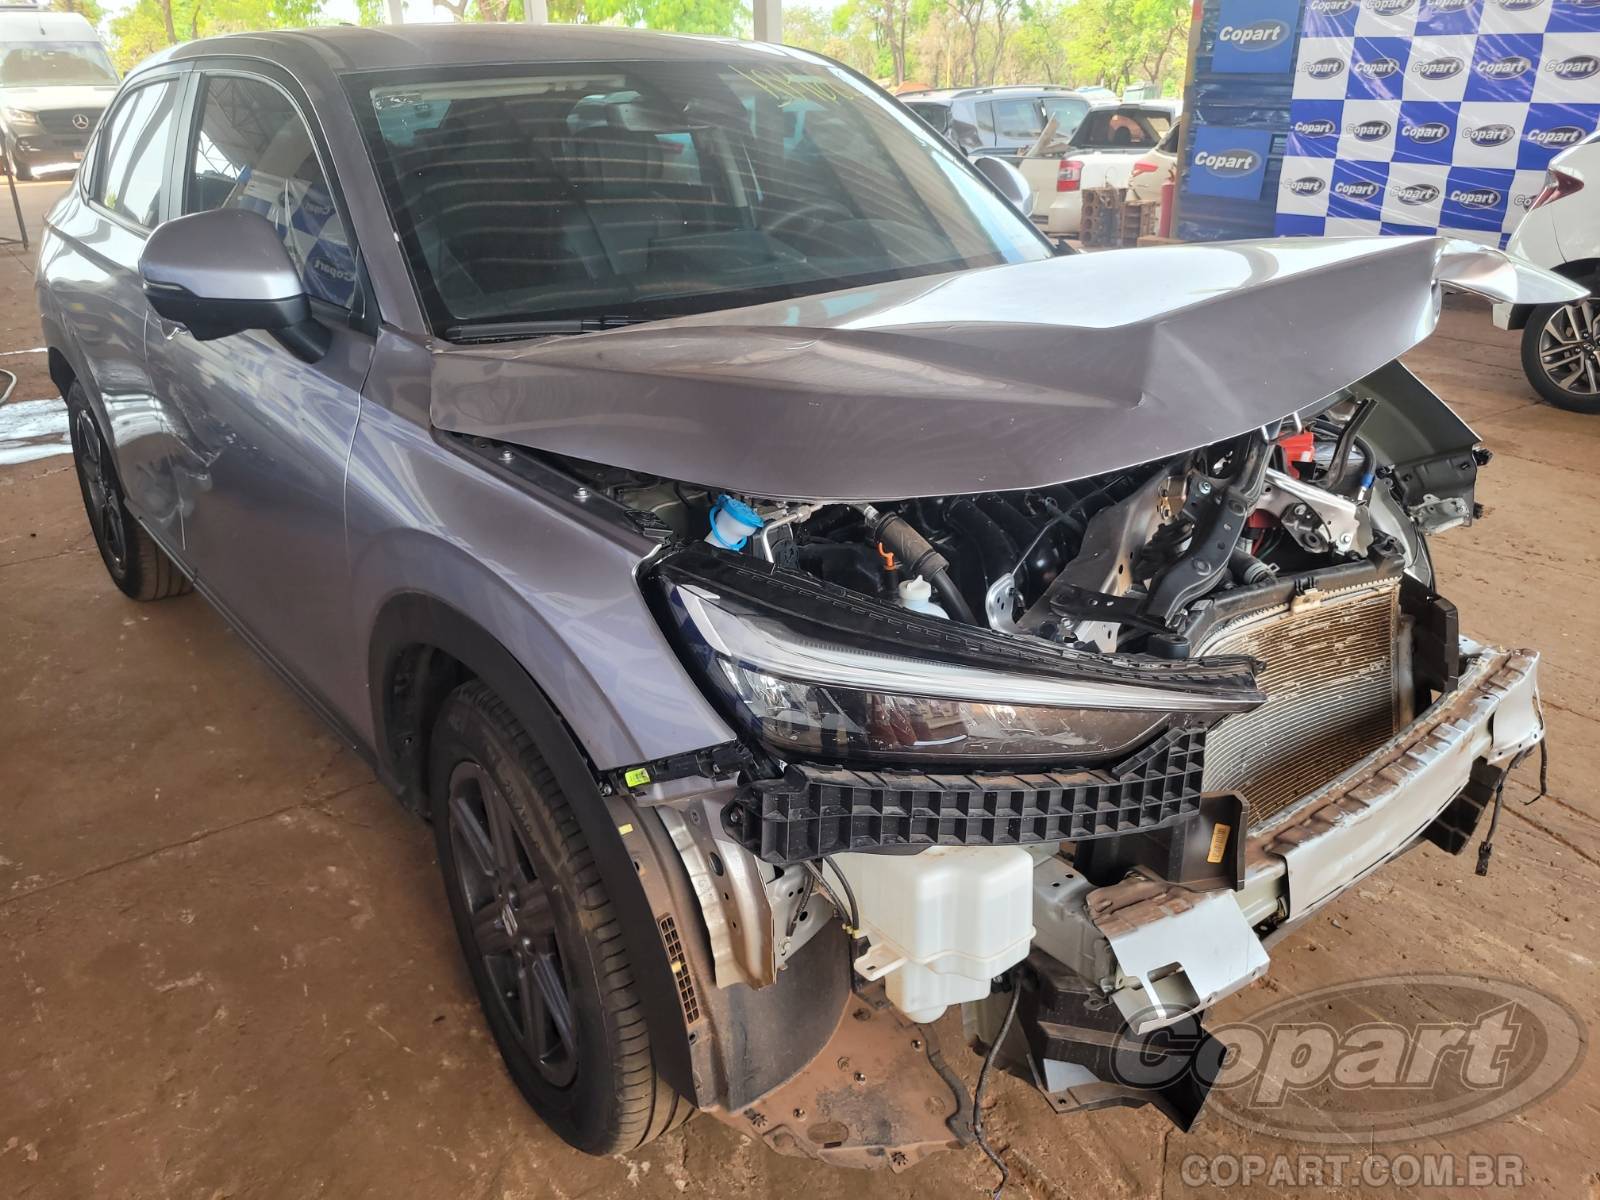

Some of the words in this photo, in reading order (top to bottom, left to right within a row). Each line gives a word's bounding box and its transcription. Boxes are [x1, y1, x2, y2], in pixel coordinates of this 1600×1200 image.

[1219, 25, 1280, 44] Copart
[1302, 60, 1339, 74] Copart
[1355, 61, 1396, 75] Copart
[1412, 60, 1457, 74] Copart
[1477, 59, 1525, 74] Copart
[1545, 59, 1595, 74] Copart
[1295, 121, 1331, 135] Copart
[1346, 123, 1385, 136] Copart
[1402, 125, 1443, 139] Copart
[1462, 127, 1507, 141] Copart
[1527, 129, 1579, 145] Copart
[1194, 151, 1252, 169] Copart
[1284, 177, 1320, 192] Copart
[1335, 182, 1374, 197] Copart
[1390, 186, 1434, 202] Copart
[1451, 190, 1495, 205] Copart
